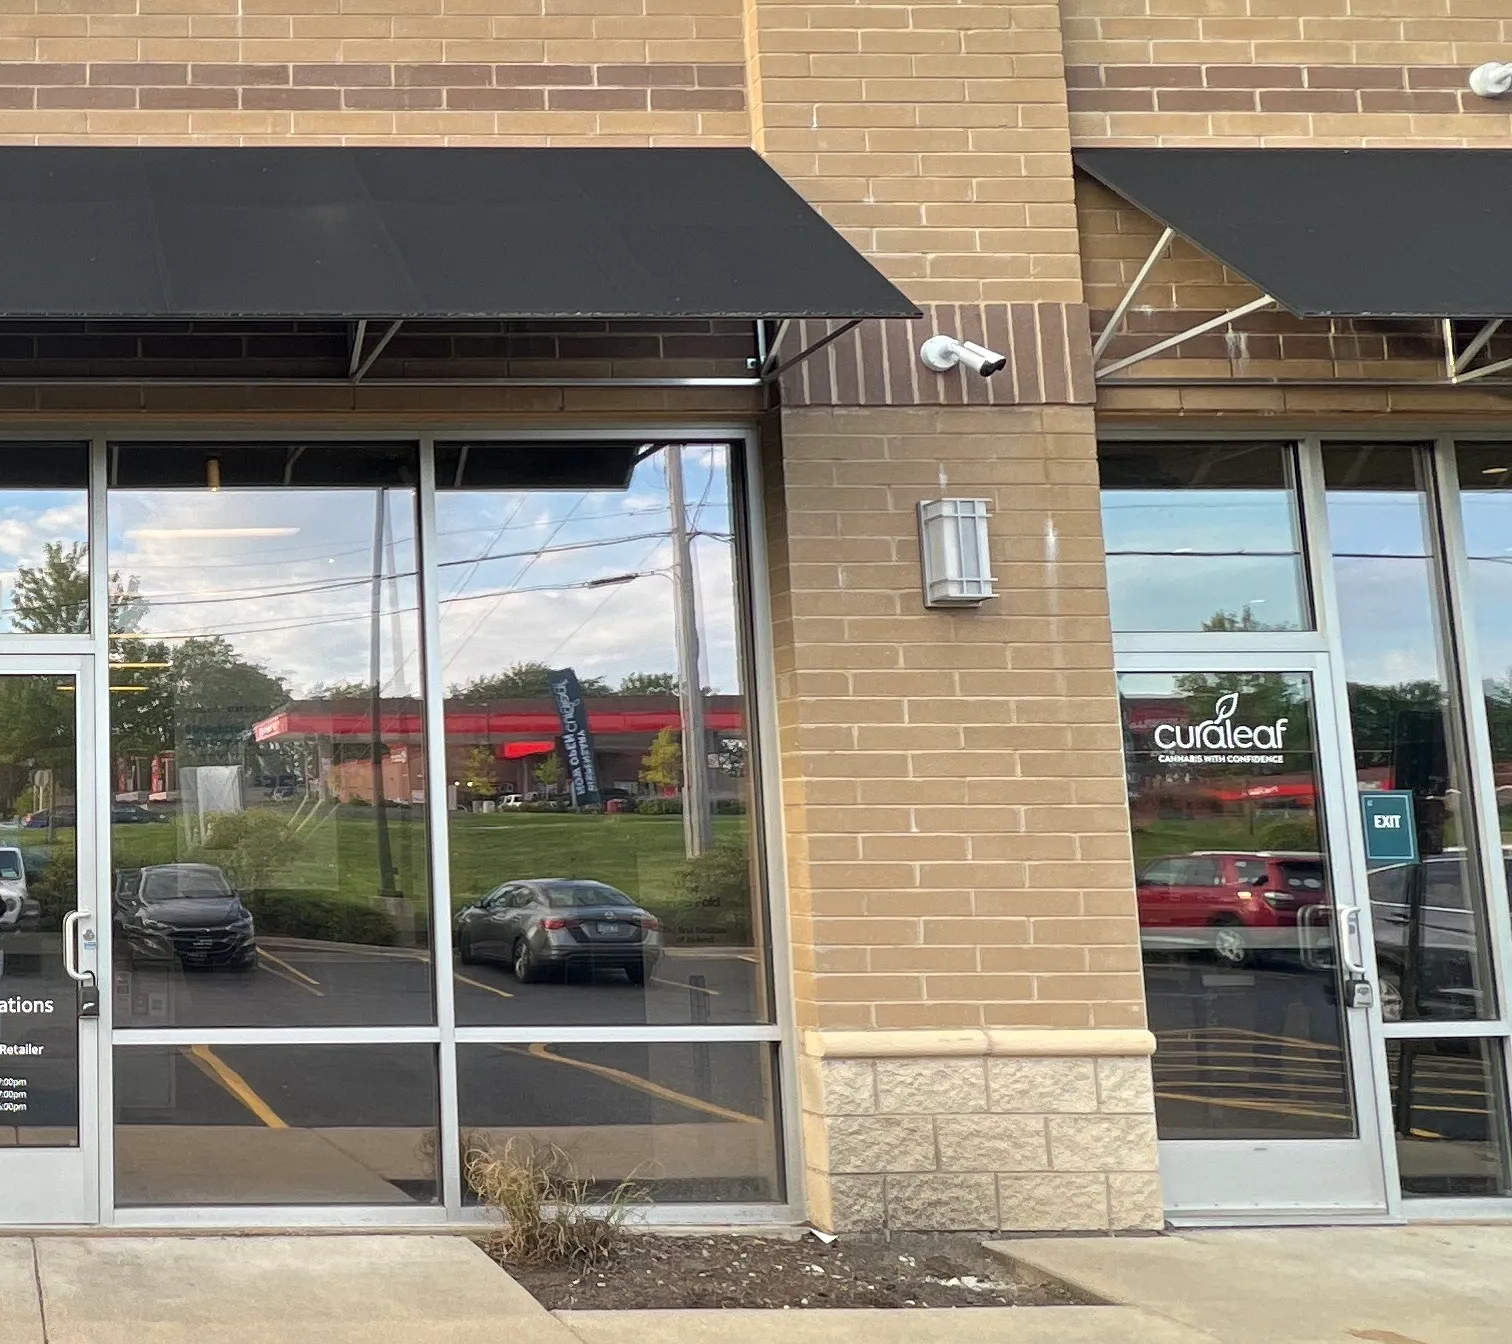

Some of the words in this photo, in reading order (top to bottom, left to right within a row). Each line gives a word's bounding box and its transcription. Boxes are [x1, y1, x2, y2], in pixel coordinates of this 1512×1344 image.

[1154, 718, 1288, 749] curaleaf
[1158, 754, 1203, 763] CANNABIS
[1203, 754, 1226, 763] WITH
[1226, 754, 1284, 764] CONFIDENCE
[1373, 814, 1402, 828] EXIT
[0, 1044, 44, 1056] Retailer
